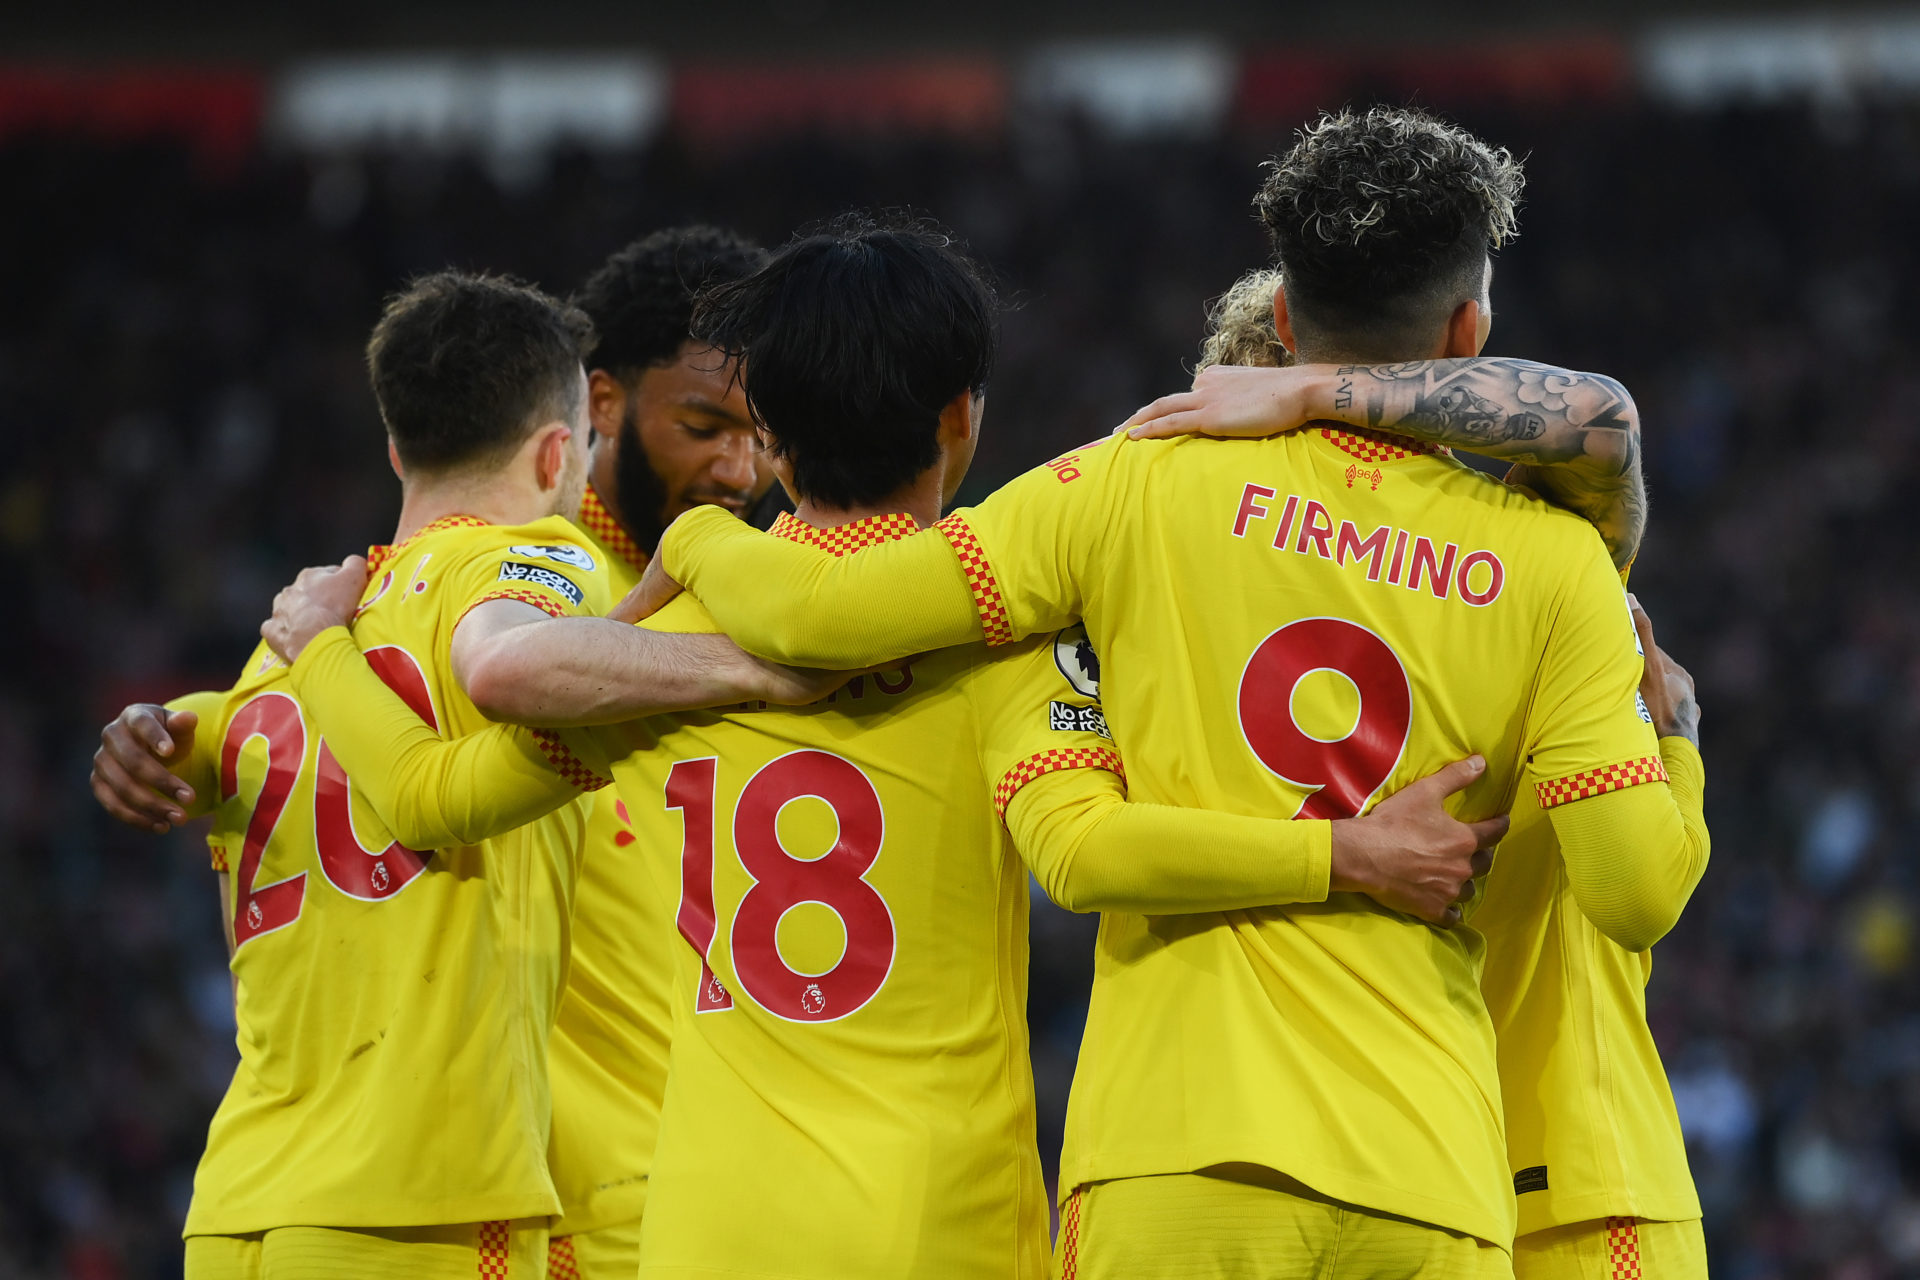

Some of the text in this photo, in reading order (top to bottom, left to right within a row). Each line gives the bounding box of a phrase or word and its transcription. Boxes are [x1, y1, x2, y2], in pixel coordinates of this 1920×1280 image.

[1526, 419, 1539, 439] LFC
[1357, 469, 1371, 480] 96
[1232, 482, 1505, 607] FIRMINO
[500, 562, 577, 595] No room
[1050, 701, 1075, 720] No
[1050, 716, 1076, 730] for
[1237, 616, 1413, 819] 9
[664, 748, 897, 1024] 18
